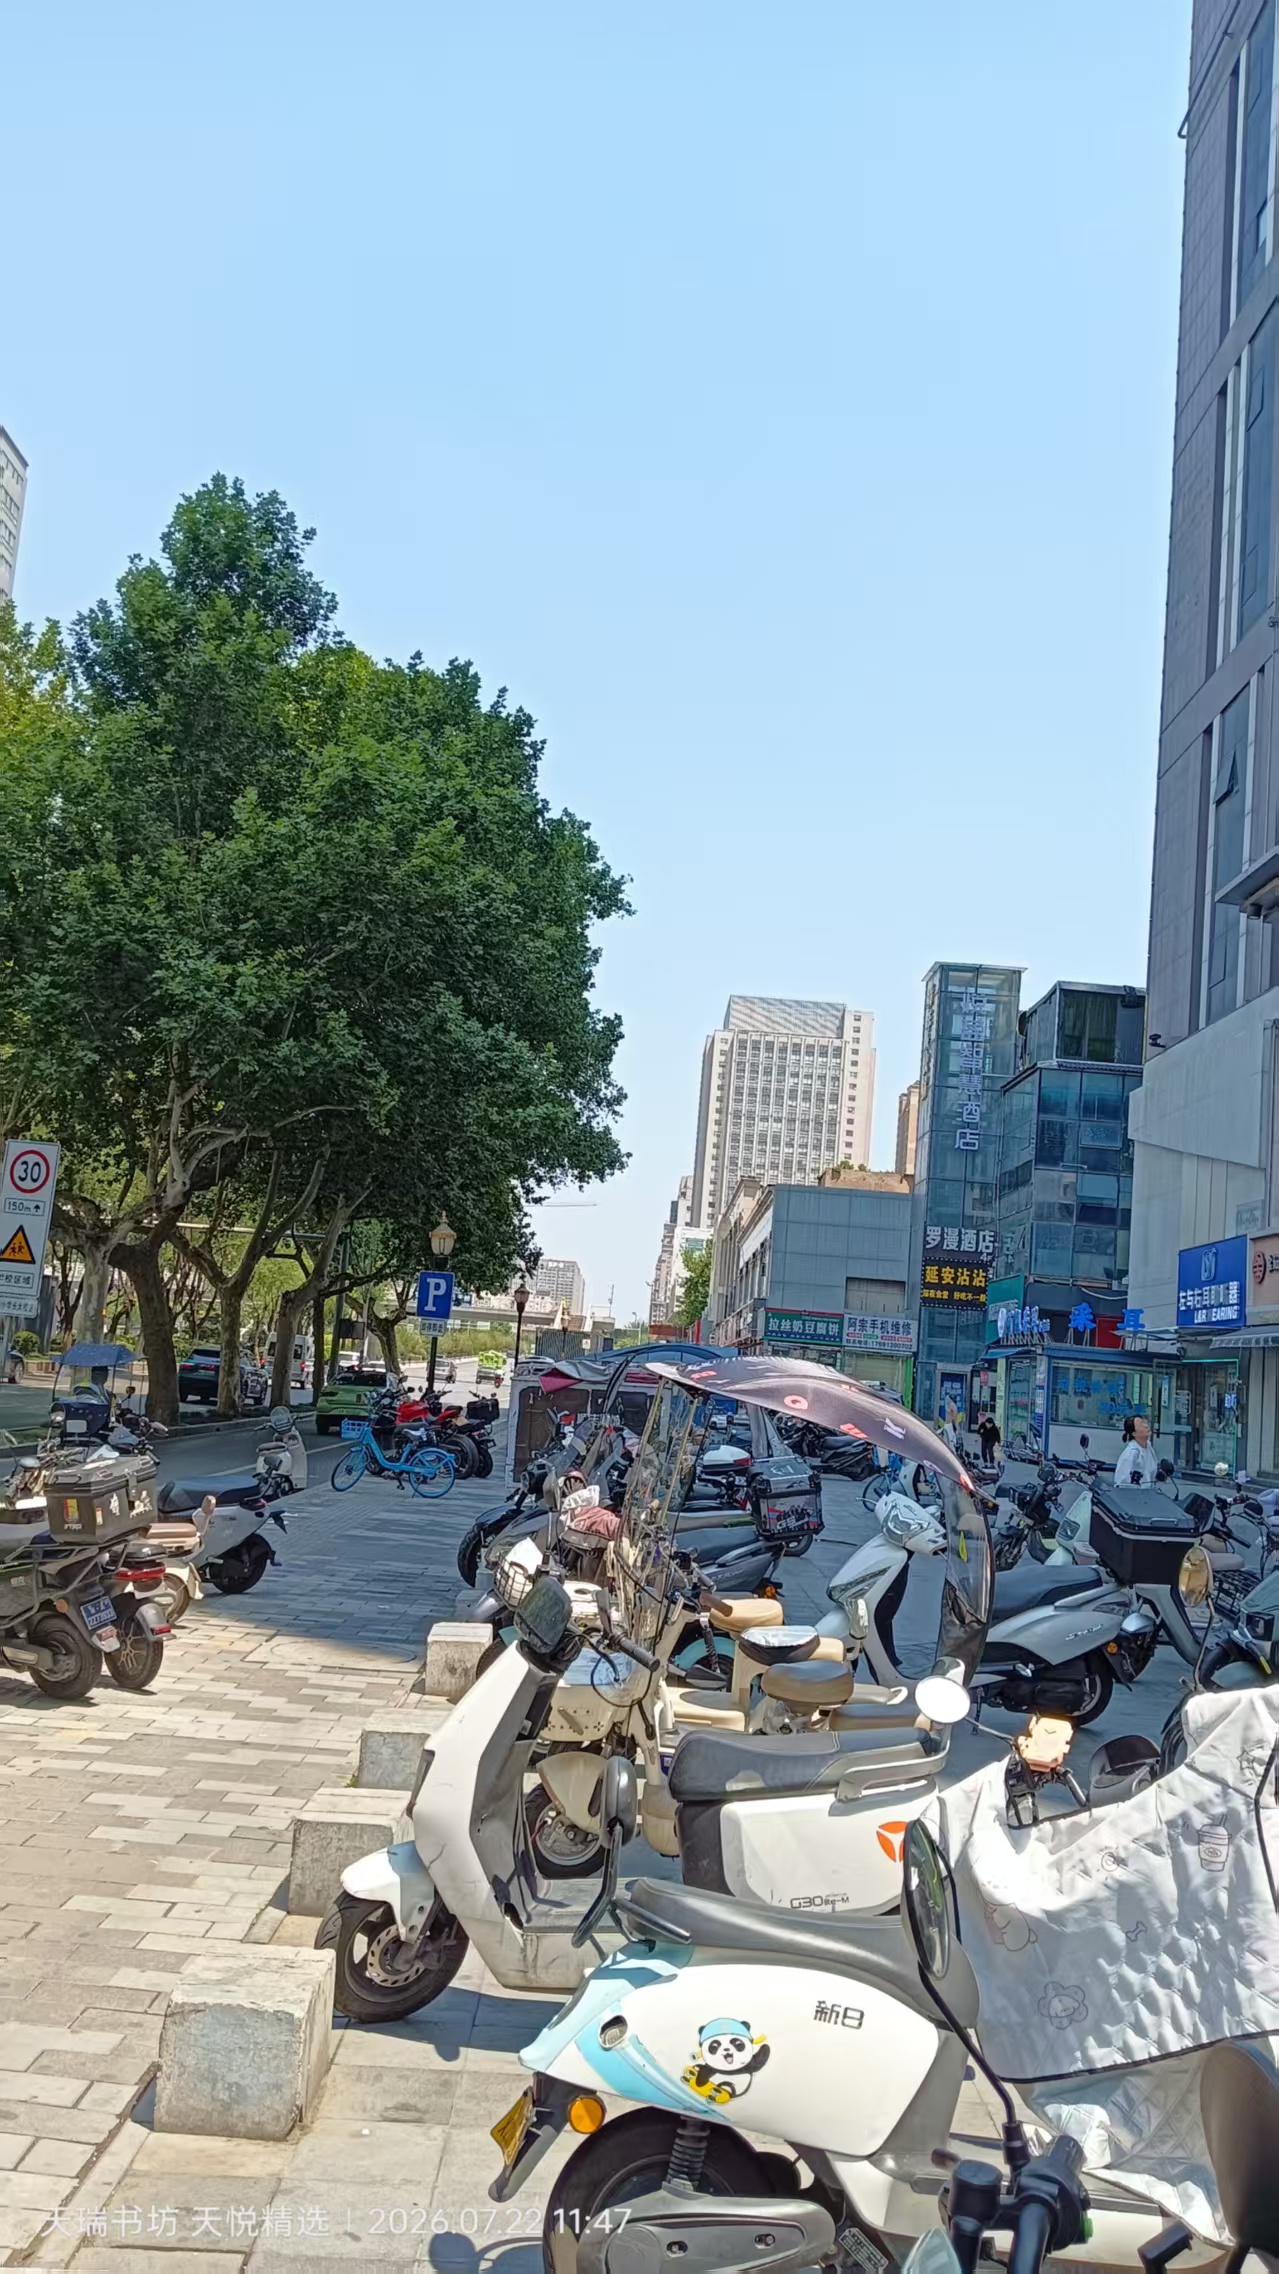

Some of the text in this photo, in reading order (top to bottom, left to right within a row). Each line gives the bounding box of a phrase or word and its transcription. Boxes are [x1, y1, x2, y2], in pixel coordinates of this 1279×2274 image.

[18, 1160, 42, 1184] 30
[7, 1201, 32, 1213] 150m
[925, 1225, 995, 1253] 罗漫酒店
[925, 1265, 987, 1288] 延安沾沾
[424, 1277, 447, 1311] P
[768, 1317, 840, 1337] 拉丝奶豆腐饼
[847, 1317, 912, 1337] 阿宗手机维修
[790, 1895, 824, 1909] G30
[813, 2000, 865, 2030] 新日
